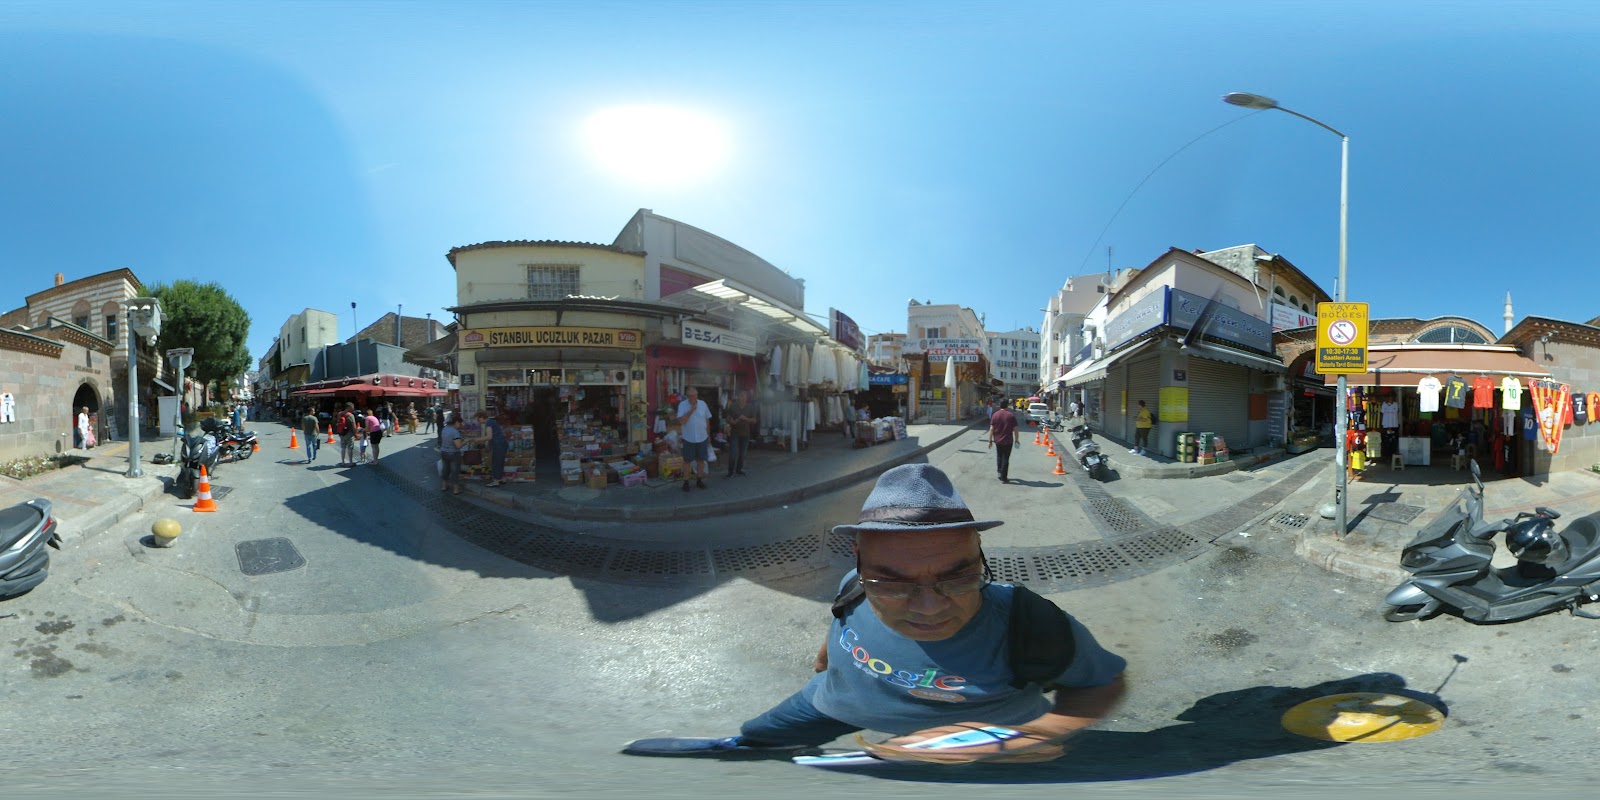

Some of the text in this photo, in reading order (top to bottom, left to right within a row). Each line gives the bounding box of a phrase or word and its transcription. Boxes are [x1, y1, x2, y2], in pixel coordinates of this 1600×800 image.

[1179, 299, 1238, 328] Keleğin
[1321, 311, 1365, 319] BÖLGESİ
[489, 330, 534, 345] İSTANBUL
[536, 331, 581, 344] UCUZLUK
[582, 331, 614, 345] PAZARI
[618, 333, 636, 342] Vilo
[1454, 384, 1461, 397] 7
[1509, 388, 1517, 399] 10
[1576, 401, 1583, 412] 7
[1524, 418, 1534, 430] 10
[839, 627, 966, 691] Google
